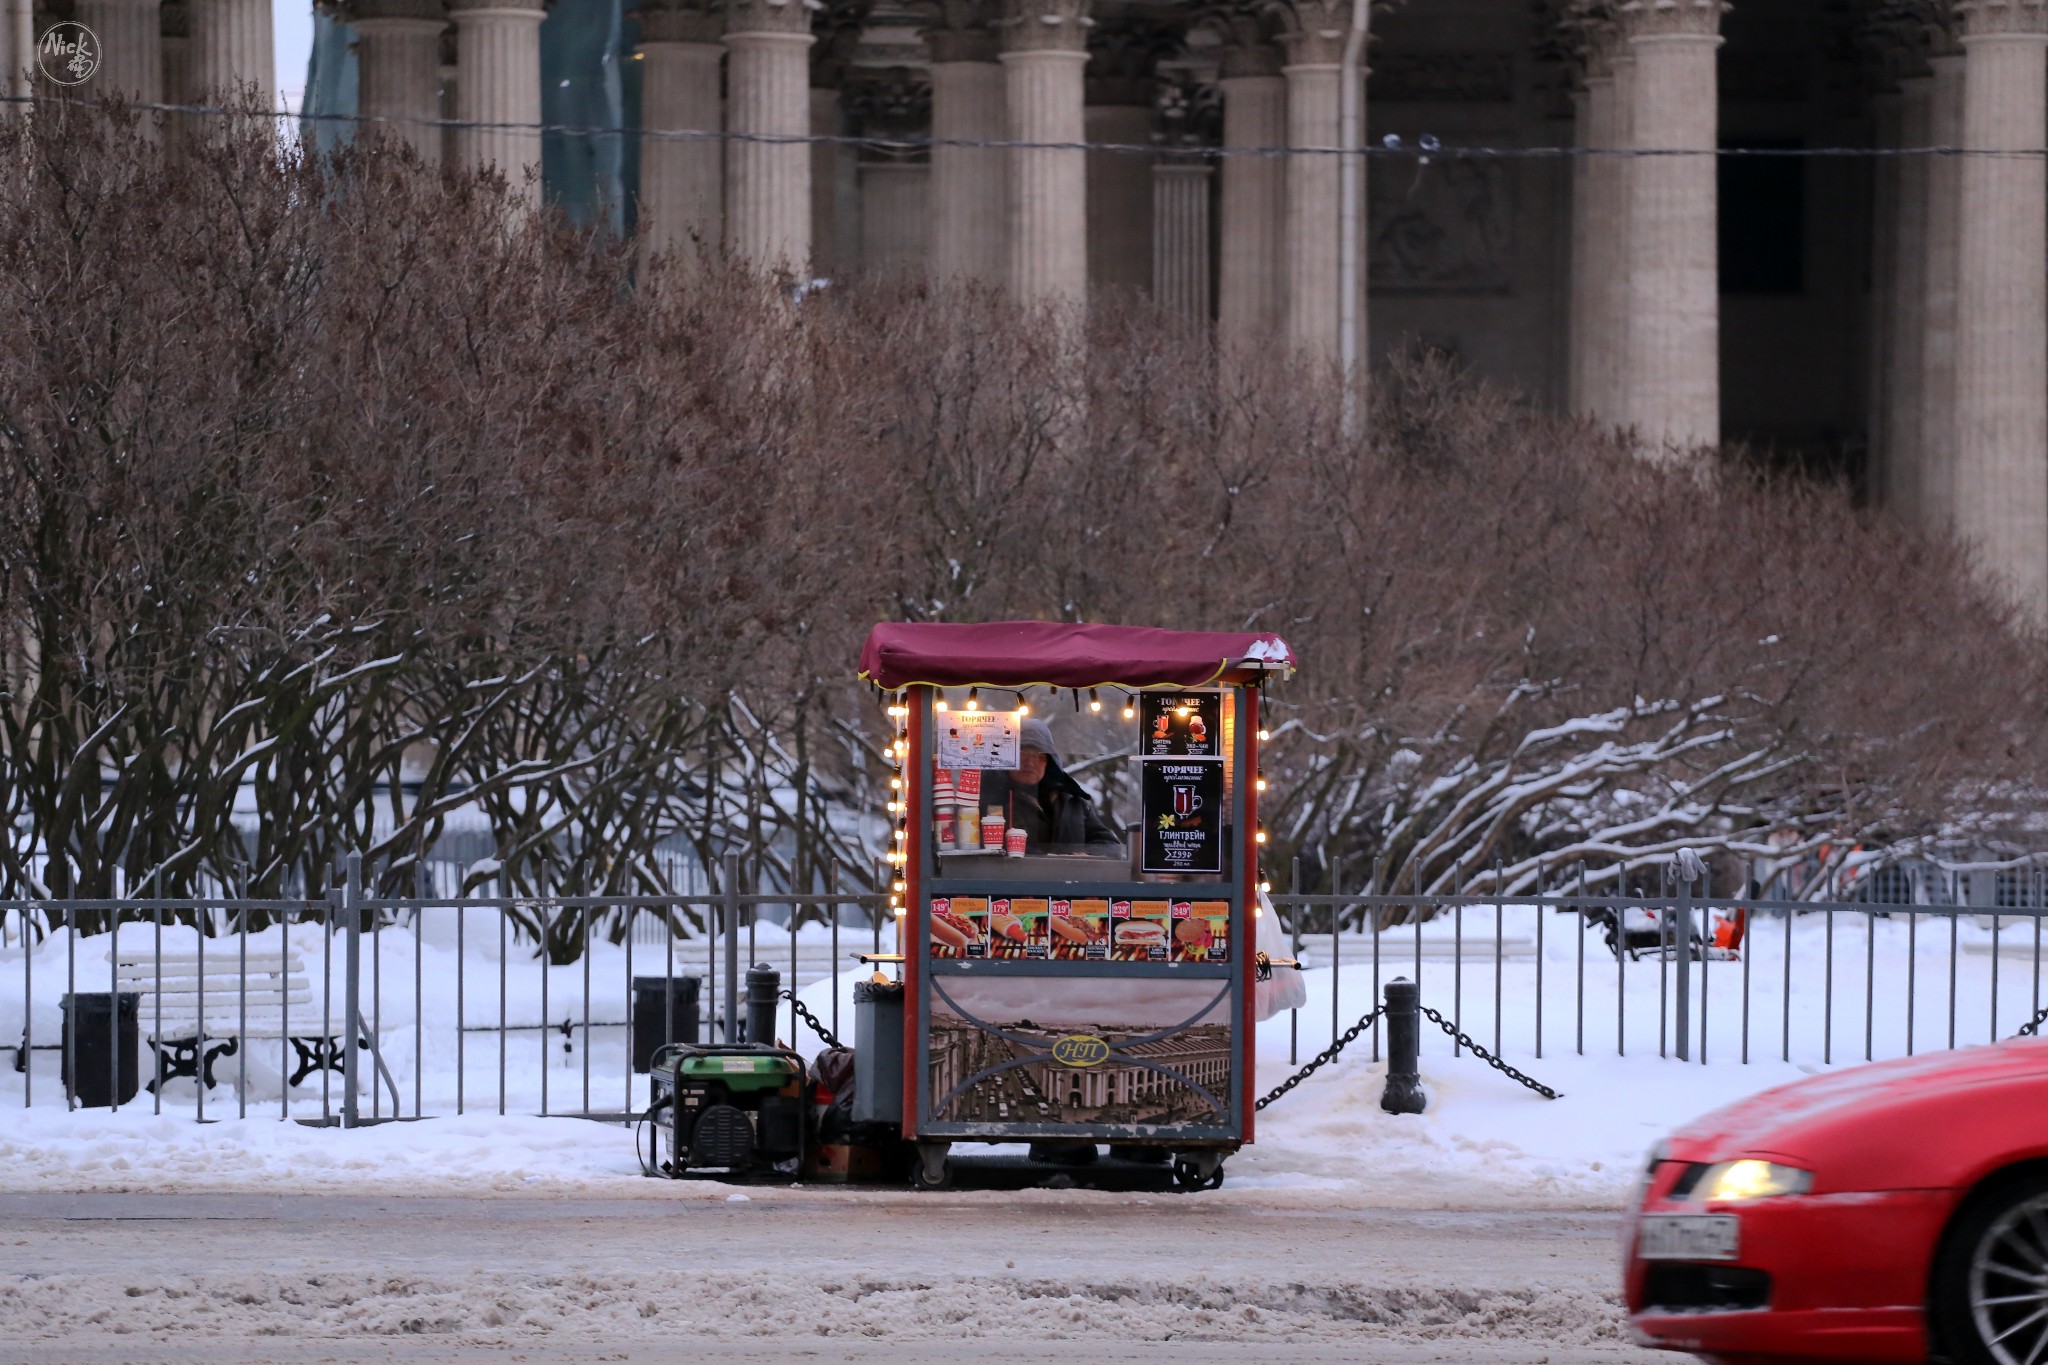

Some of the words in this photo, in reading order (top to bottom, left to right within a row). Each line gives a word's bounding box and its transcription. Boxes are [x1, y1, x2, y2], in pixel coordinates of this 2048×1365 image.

[1160, 697, 1201, 706] ГОЧЕЕ
[961, 715, 996, 723] ГОРЯЧЕЕ
[1162, 765, 1204, 773] ГОРЯЧЕЕ
[1159, 829, 1206, 841] ГЛИНТВЕЙН
[1060, 1042, 1101, 1059] НП
